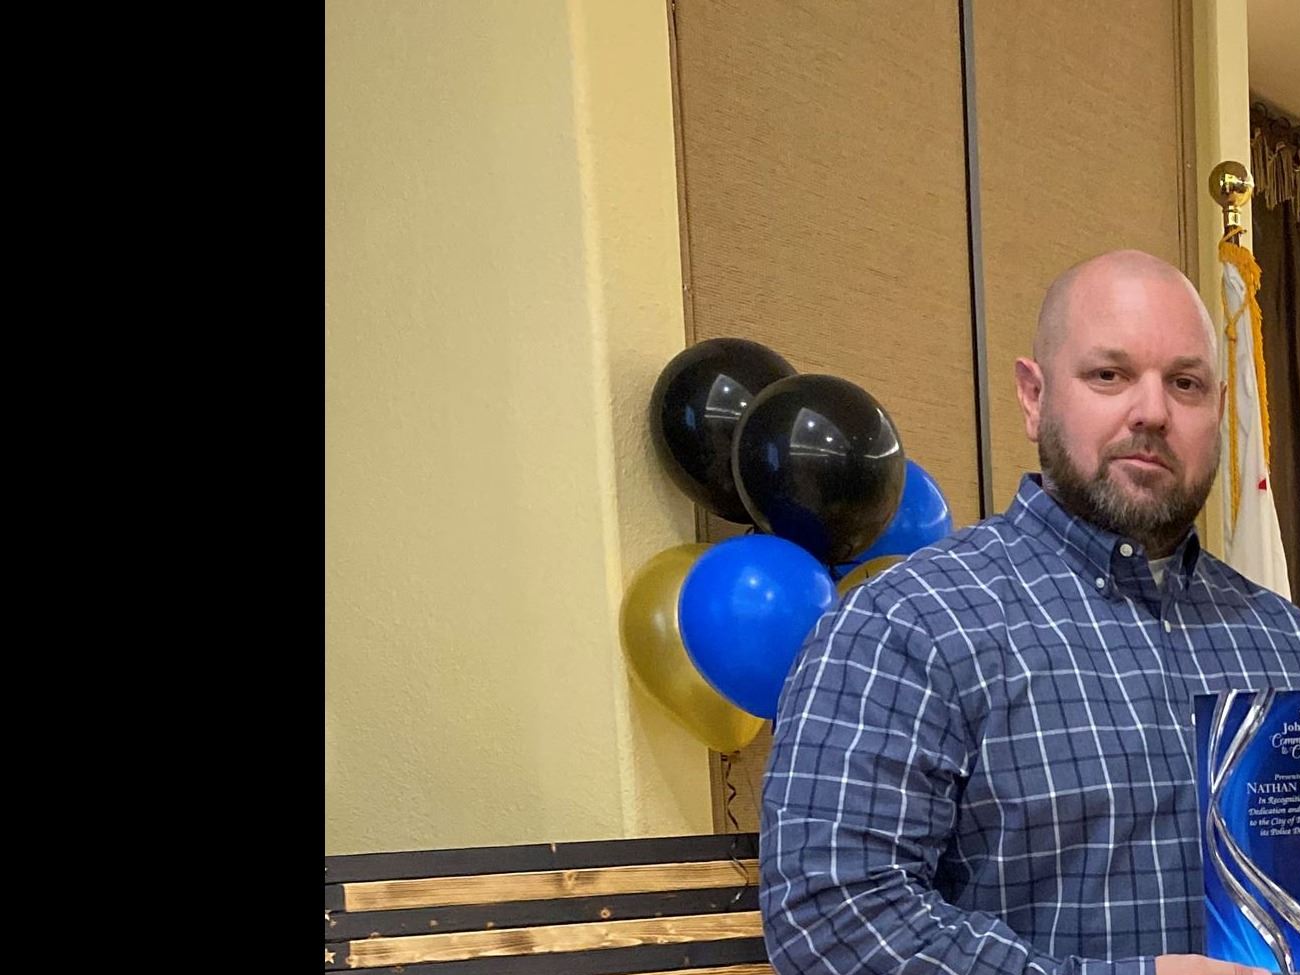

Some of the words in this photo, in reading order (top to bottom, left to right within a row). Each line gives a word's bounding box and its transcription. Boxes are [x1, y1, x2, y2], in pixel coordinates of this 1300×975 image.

[1248, 807, 1286, 816] Dedication
[1259, 817, 1269, 826] the
[1271, 817, 1286, 827] City
[1287, 815, 1295, 825] of
[1260, 828, 1269, 836] its
[1270, 827, 1291, 836] Police
